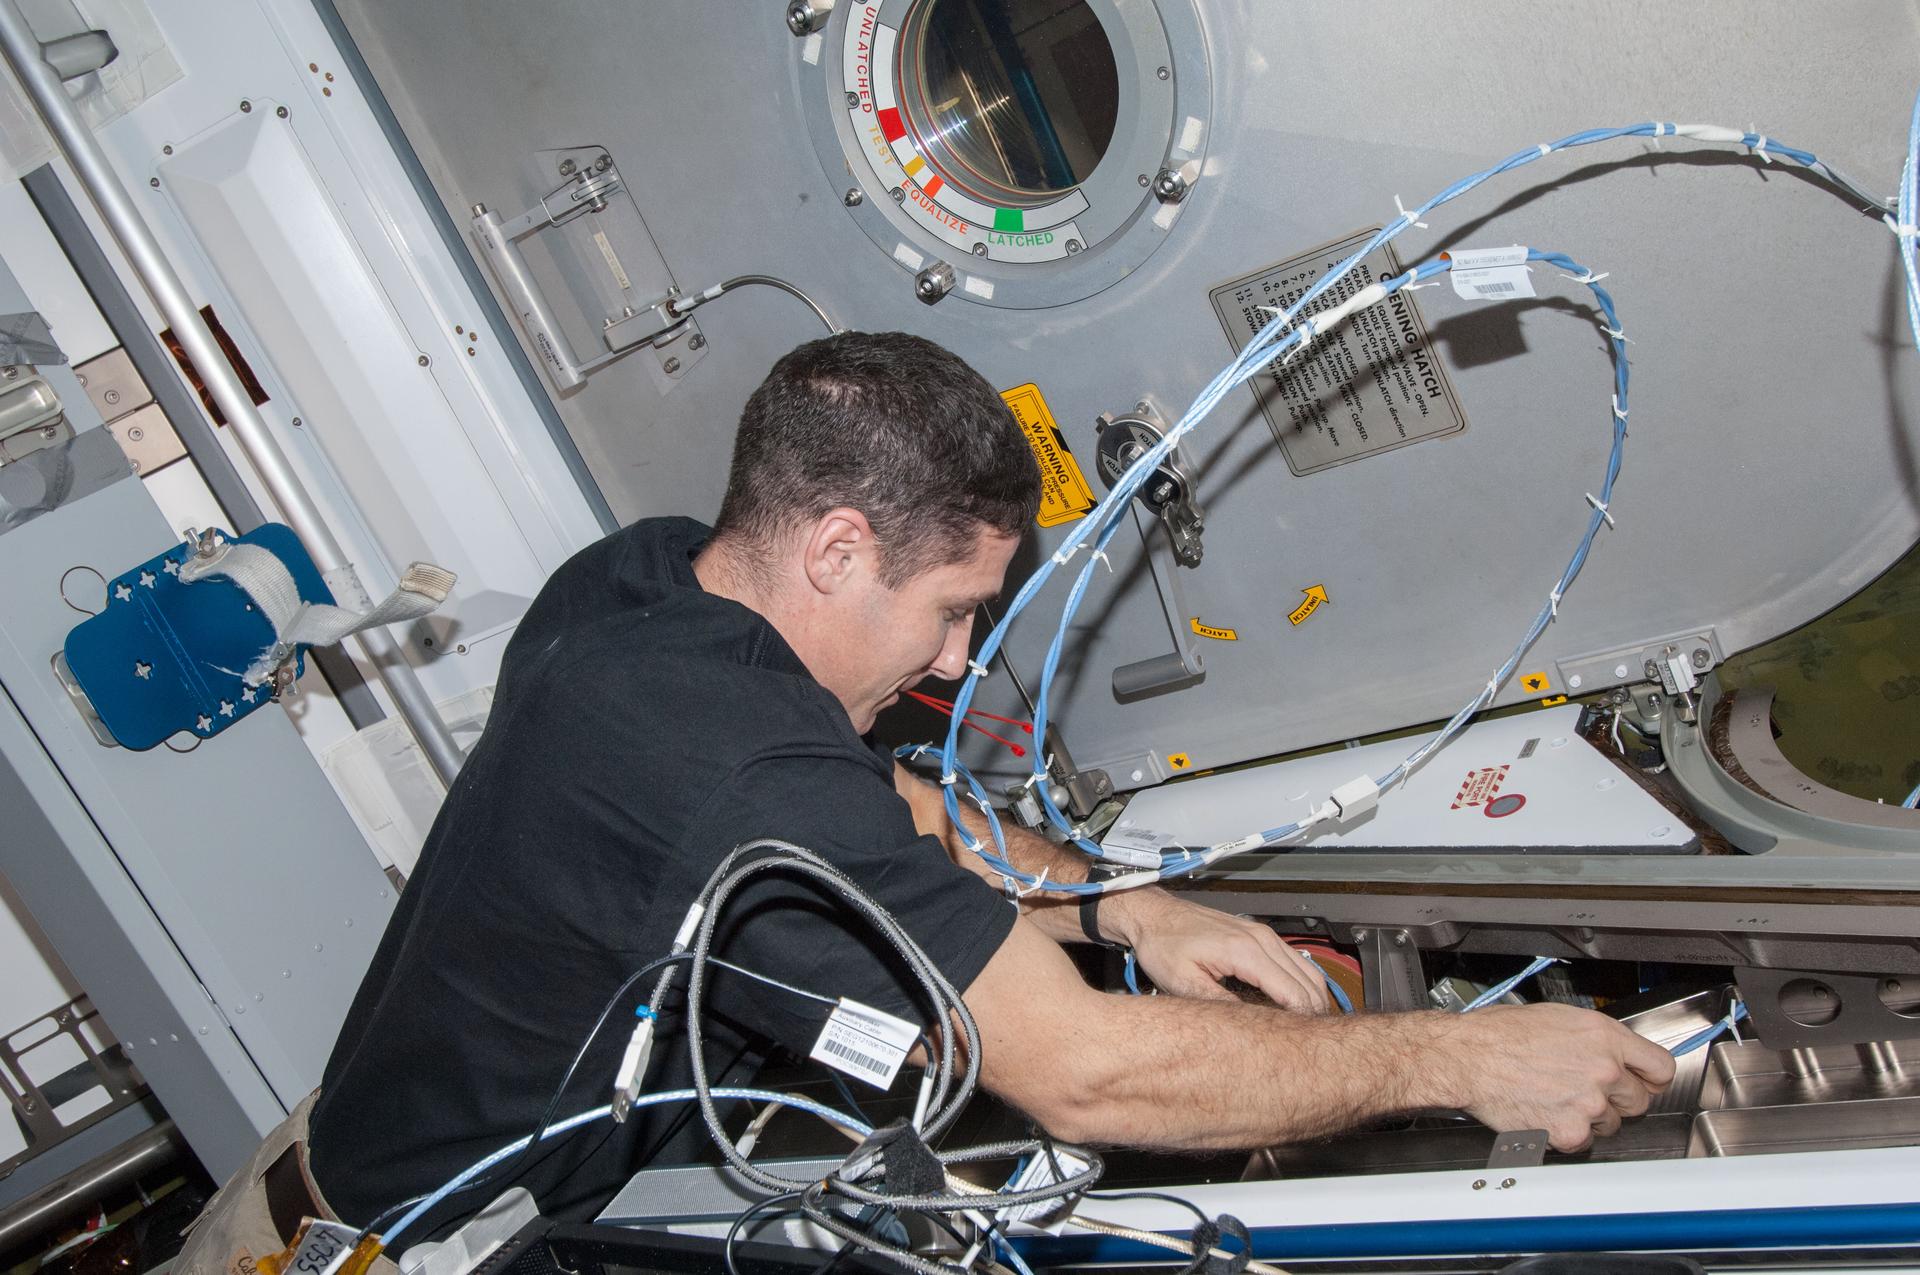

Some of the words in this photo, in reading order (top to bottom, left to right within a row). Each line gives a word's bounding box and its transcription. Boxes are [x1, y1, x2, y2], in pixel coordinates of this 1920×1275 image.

[857, 6, 876, 113] UNLATCHED
[868, 126, 895, 165] TEST
[901, 179, 968, 236] EQUALIZE
[987, 232, 1054, 247] LATCHED
[1235, 291, 1245, 304] 12.
[1271, 370, 1289, 401] HANDLE
[1287, 406, 1299, 421] Pull
[1293, 421, 1303, 434] up.
[1243, 288, 1254, 301] 11.
[1280, 367, 1298, 398] BUTTON
[1260, 281, 1271, 294] 10.
[1297, 361, 1316, 393] HANDLE
[1313, 397, 1325, 412] Pull
[1319, 413, 1329, 426] up.
[1327, 426, 1341, 447] Move
[1272, 282, 1280, 291] 9.
[1308, 364, 1319, 380] out.
[1281, 279, 1289, 288] 8.
[1314, 356, 1333, 388] position.
[1289, 275, 1298, 284] 7.
[1315, 333, 1342, 383] QUALIZATION
[1338, 384, 1352, 407] VALVE
[1351, 412, 1368, 442] CLOSED.
[1299, 272, 1307, 281] 6.
[1333, 352, 1350, 380] Stowed
[1345, 381, 1364, 414] position.
[1307, 268, 1316, 278] 5.
[1334, 330, 1359, 377] UNLATCHED.
[1350, 268, 1364, 290] CRAN
[1366, 305, 1381, 330] ANDLE
[1378, 336, 1398, 370] Engaged
[1392, 371, 1412, 404] position.
[1358, 312, 1378, 348] UNLATCH
[1372, 349, 1391, 382] position.
[1376, 304, 1405, 362] EQUALIZATION
[1401, 363, 1416, 386] VALVE
[1414, 393, 1429, 417] OPEN.
[1377, 270, 1418, 345] OENING
[1410, 347, 1441, 398] HATCH
[1293, 374, 1310, 402] stowed
[1304, 402, 1324, 434] position.
[1360, 342, 1373, 360] Turn
[1368, 361, 1376, 370] in
[1373, 370, 1392, 406] UNLATCH
[1388, 406, 1406, 438] direction
[1012, 403, 1029, 431] FAILURE
[1027, 432, 1035, 443] TO
[1032, 443, 1052, 475] EQUALIZE
[1049, 475, 1070, 510] PRESSURE
[1030, 420, 1069, 484] WARNING
[1043, 490, 1054, 505] AND
[1044, 478, 1055, 493] CAN
[1200, 627, 1228, 638] LATCH
[1293, 595, 1319, 622] UNLATCH
